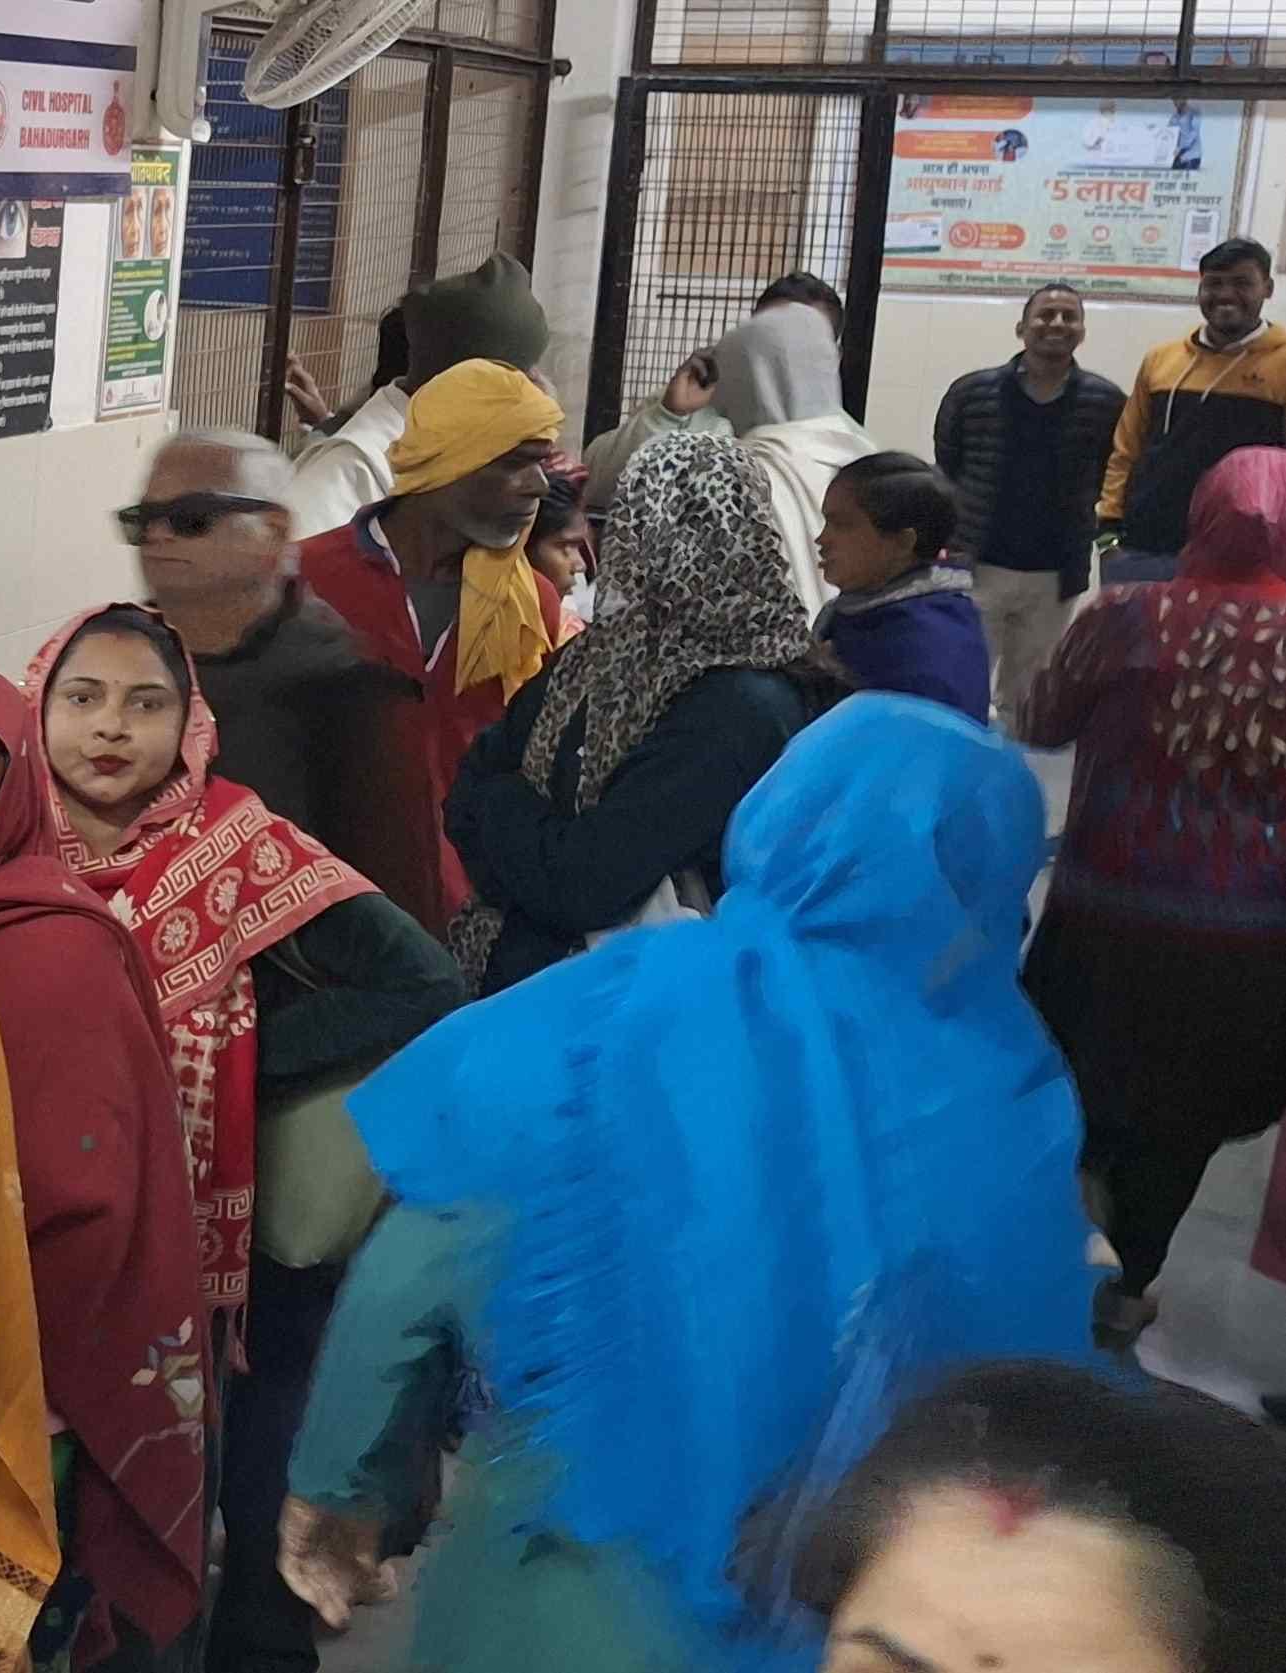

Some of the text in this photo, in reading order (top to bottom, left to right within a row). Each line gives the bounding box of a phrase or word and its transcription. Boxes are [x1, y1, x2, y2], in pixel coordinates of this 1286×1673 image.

[21, 89, 93, 114] CIVIL HOSPITAL
[19, 127, 91, 149] BAHADURGARH
[1074, 179, 1151, 203] लाख
